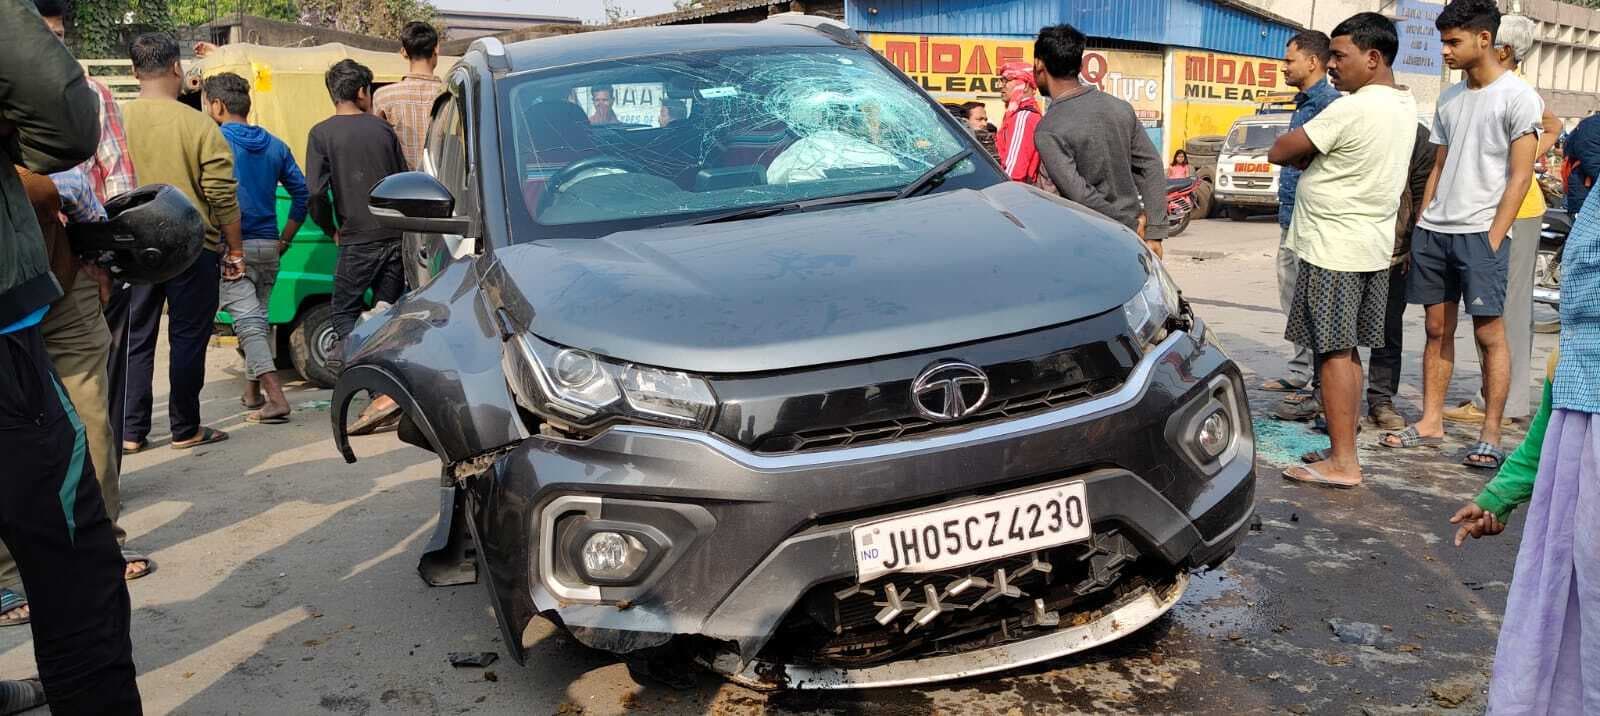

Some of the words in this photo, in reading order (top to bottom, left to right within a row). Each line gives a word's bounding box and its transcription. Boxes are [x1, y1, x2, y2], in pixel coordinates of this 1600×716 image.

[1185, 53, 1278, 88] MIDAS
[883, 495, 1084, 569] JH05CZ4230
[860, 548, 879, 560] IND
